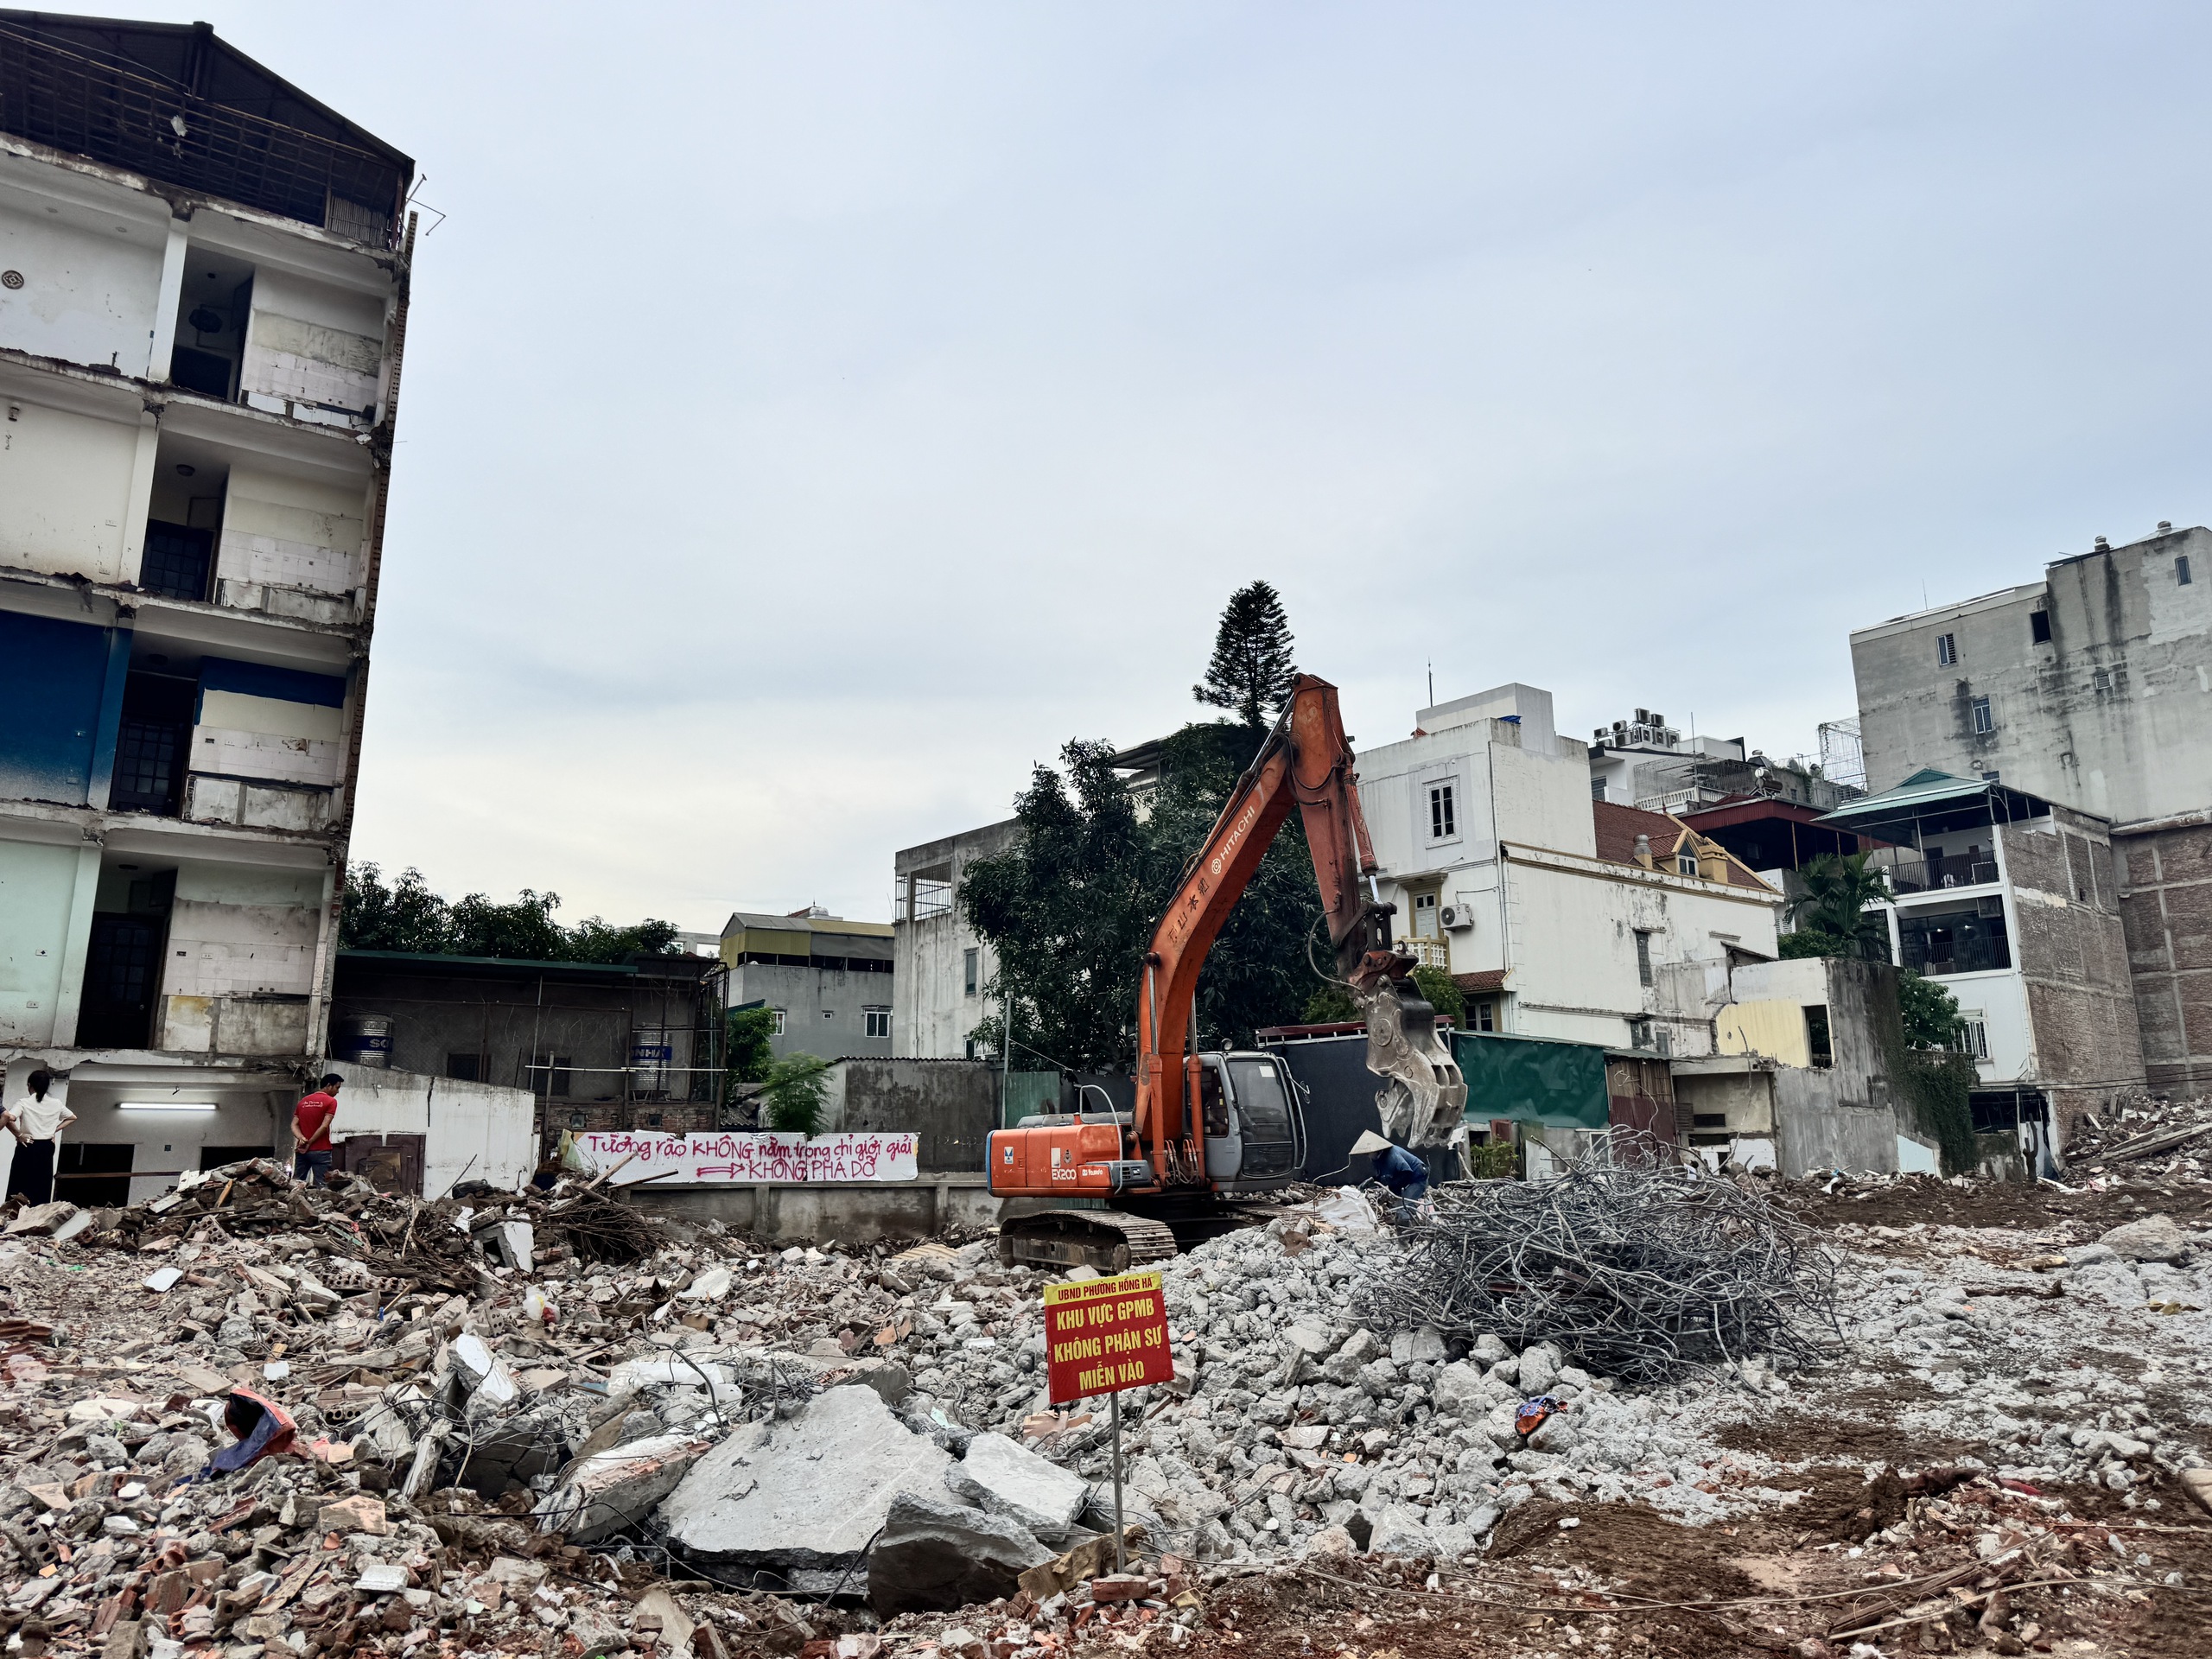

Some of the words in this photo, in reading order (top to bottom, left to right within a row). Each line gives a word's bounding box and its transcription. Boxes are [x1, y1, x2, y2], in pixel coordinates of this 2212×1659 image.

[1220, 805, 1255, 861] HITACHI
[692, 1134, 754, 1160] KHÔNG
[759, 1136, 792, 1158] nằm
[793, 1141, 830, 1162] trong
[834, 1134, 854, 1156] chỉ
[855, 1135, 882, 1161] giới
[887, 1135, 912, 1161] giải
[749, 1158, 807, 1180] KHÔNG
[812, 1156, 847, 1179] PHÁ
[1052, 1168, 1077, 1180] EX200
[1058, 1287, 1082, 1300] UBND
[1084, 1281, 1116, 1297] PHƯỜNG
[1118, 1276, 1140, 1292] HỒNG
[1141, 1275, 1153, 1288] HÀ
[1057, 1308, 1084, 1331] KHU
[1088, 1303, 1114, 1328] VỰC
[1117, 1298, 1154, 1322] GPMB
[1054, 1337, 1102, 1363] KHÔNG
[1105, 1328, 1141, 1354] PHẬN
[1144, 1324, 1162, 1349] SỰ
[1078, 1361, 1116, 1390] MIỄN
[1118, 1358, 1145, 1382] VÀO
